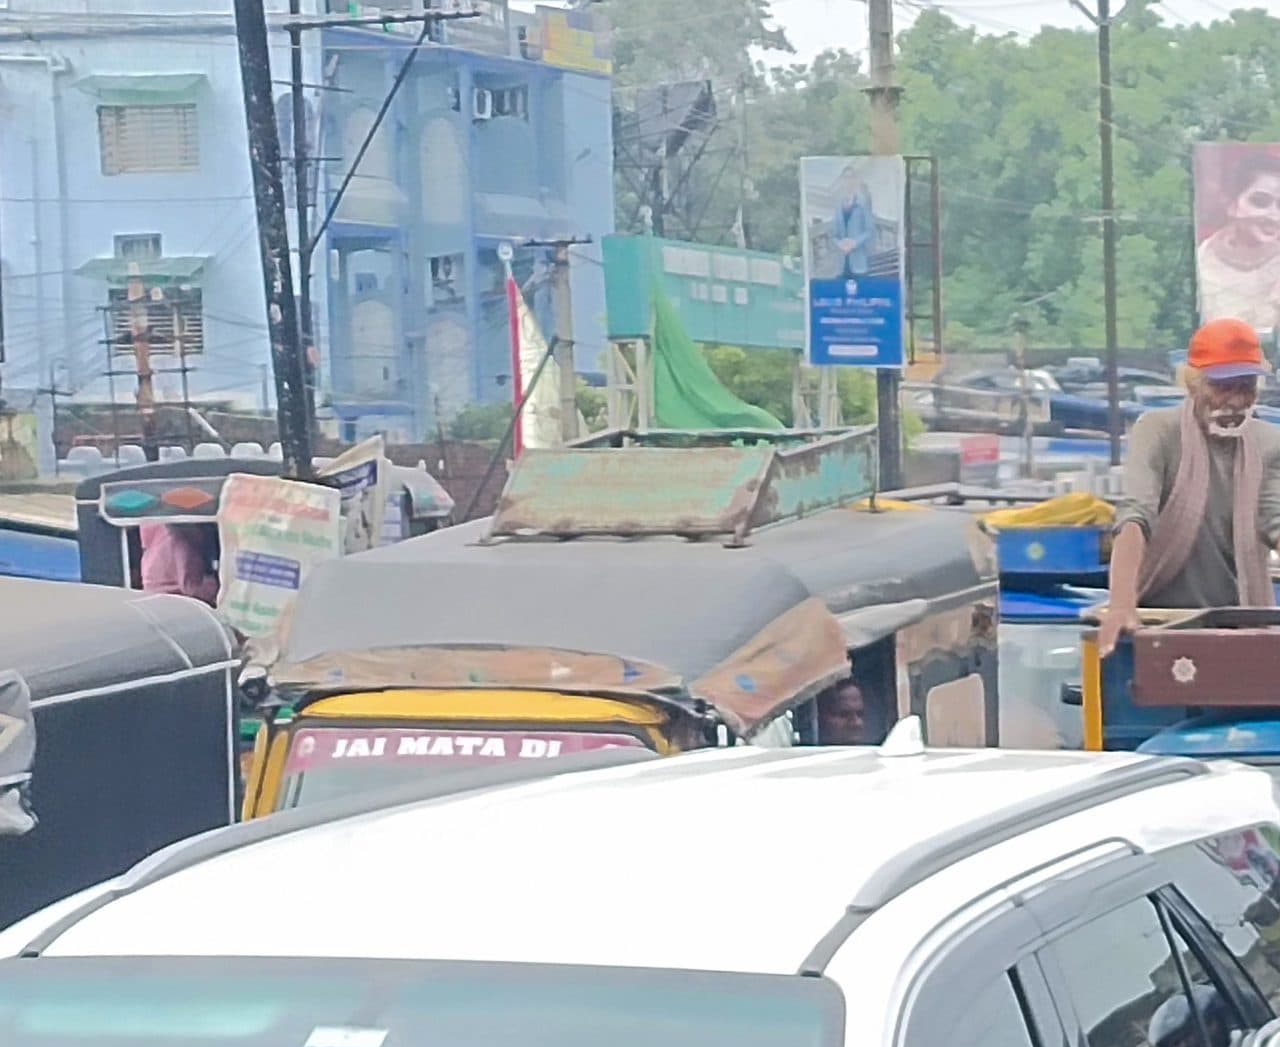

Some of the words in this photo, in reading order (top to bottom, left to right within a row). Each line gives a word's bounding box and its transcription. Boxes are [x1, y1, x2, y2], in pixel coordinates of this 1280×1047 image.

[332, 737, 387, 758] JAI
[397, 736, 506, 757] MATA
[518, 739, 563, 758] DI
